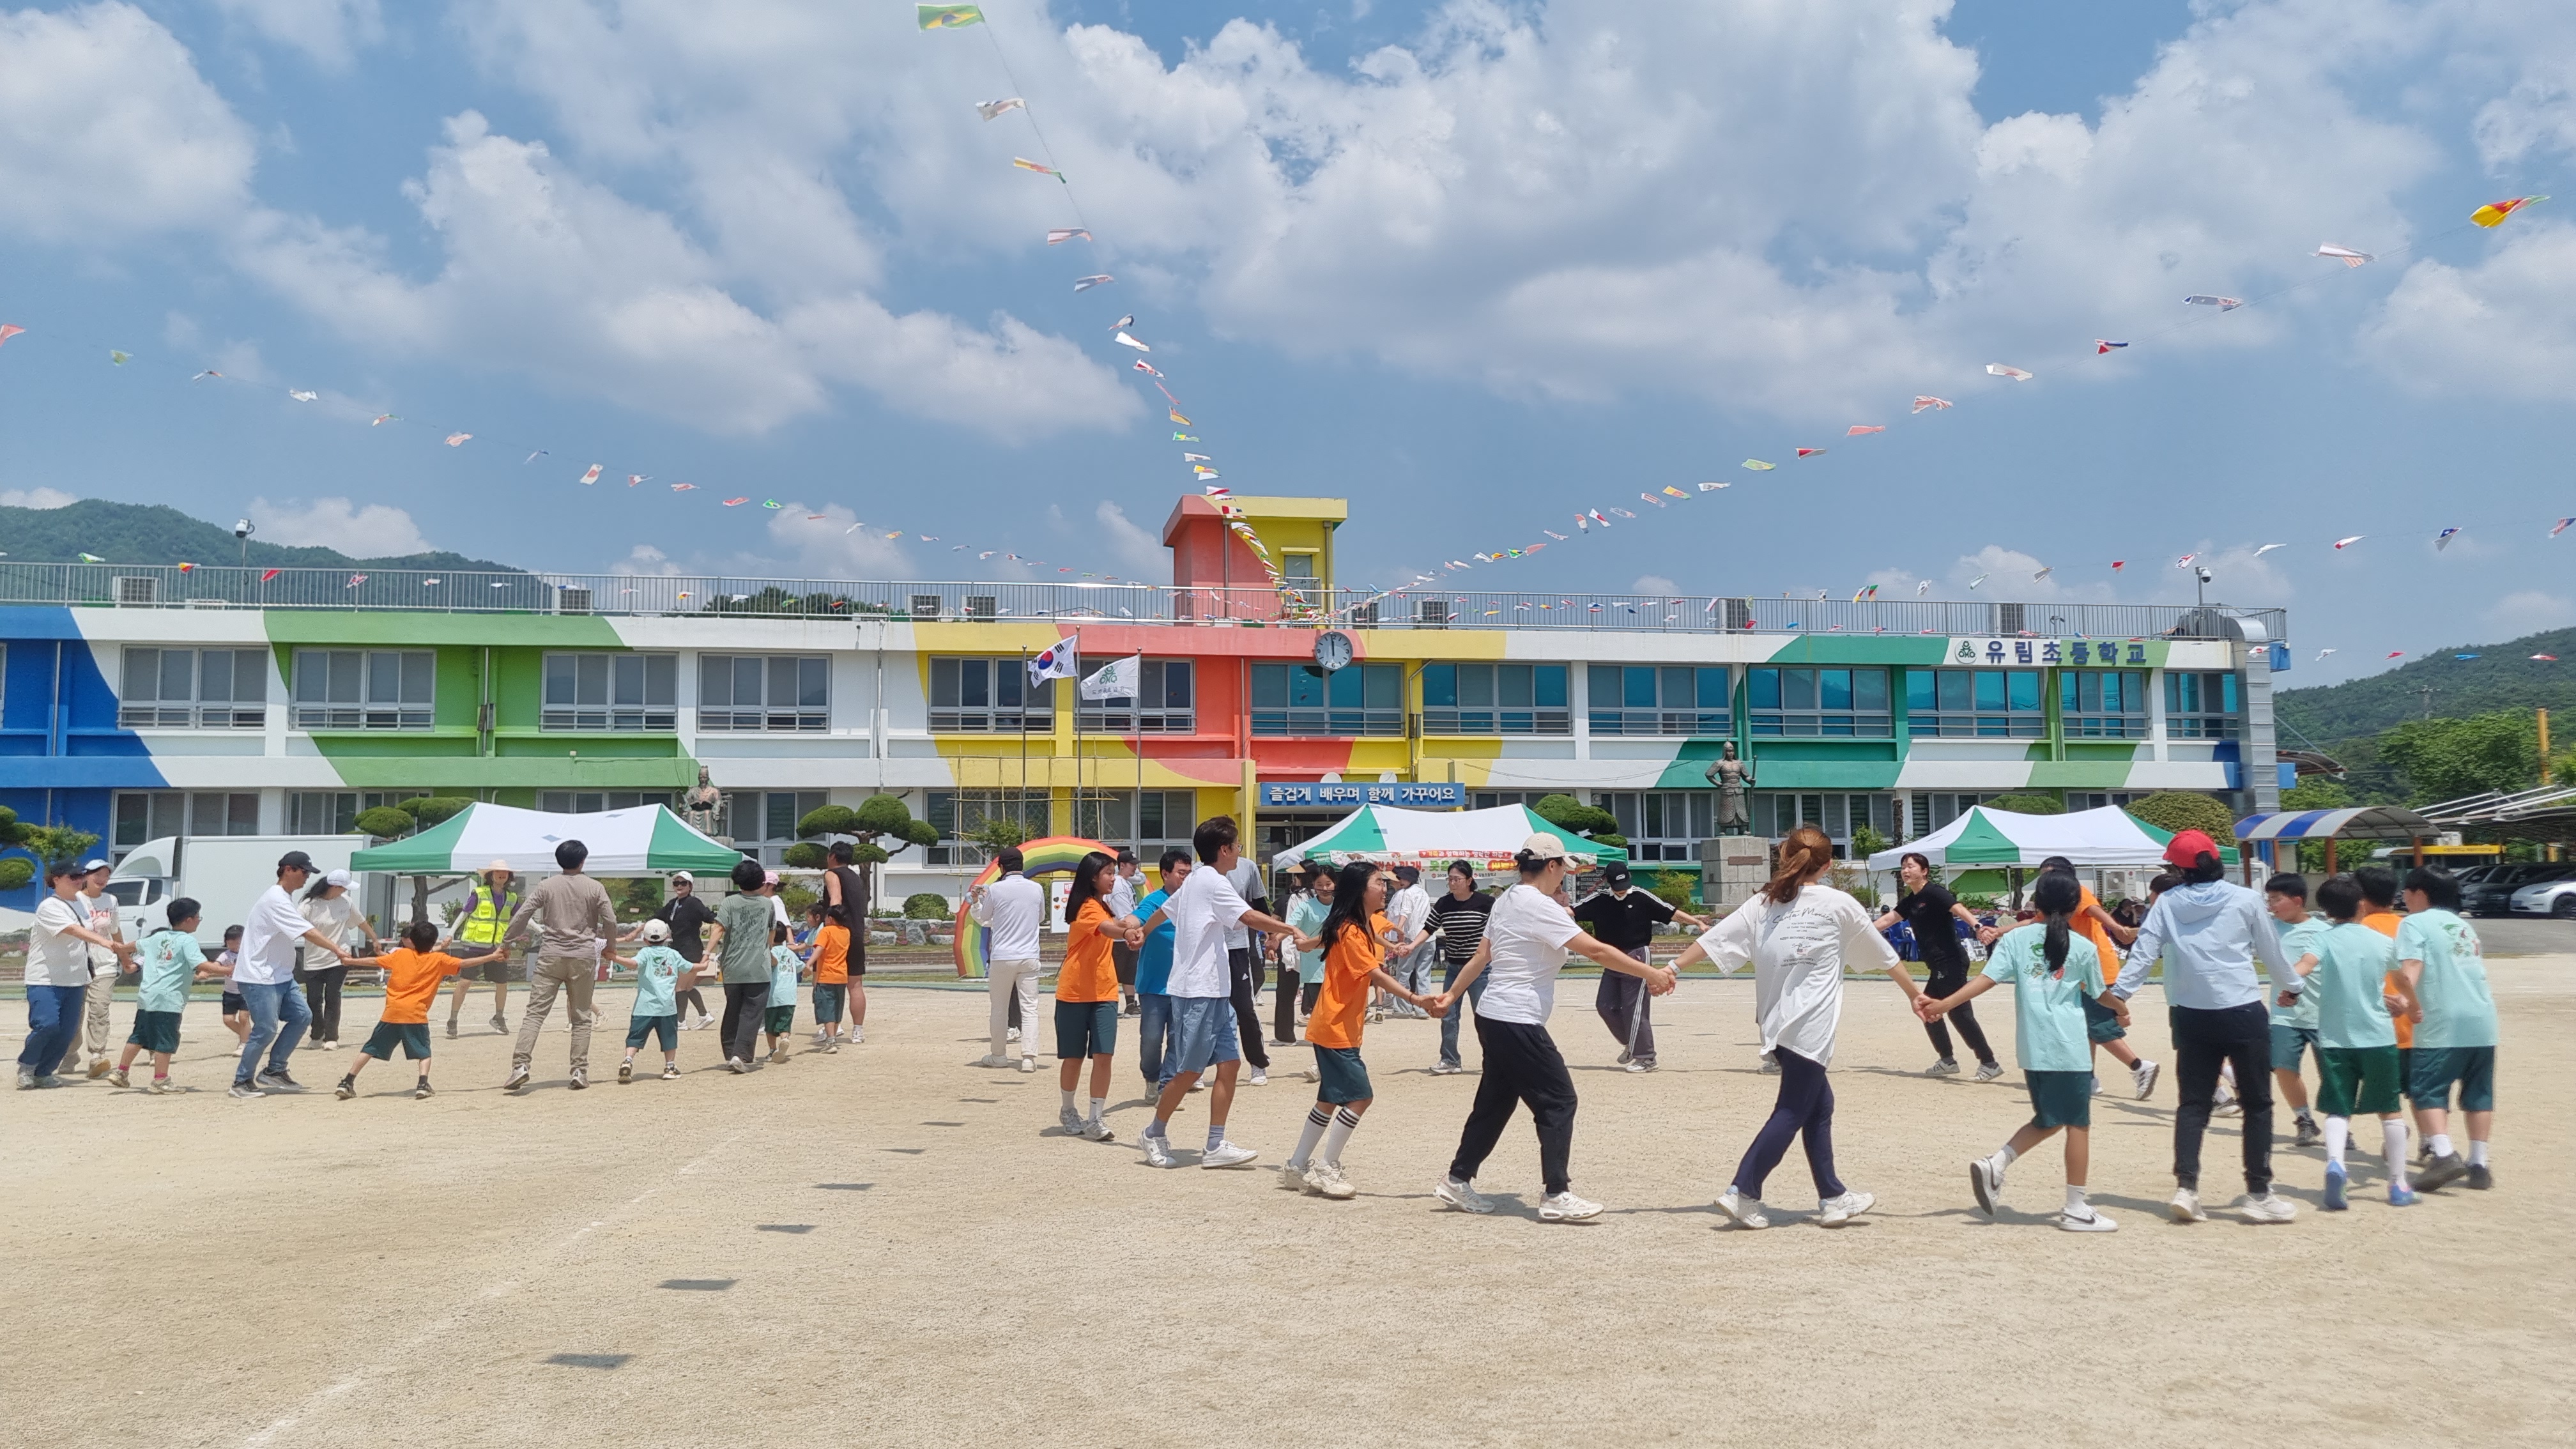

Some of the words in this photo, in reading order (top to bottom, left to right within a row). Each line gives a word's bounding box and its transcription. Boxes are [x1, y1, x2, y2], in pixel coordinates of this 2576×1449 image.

[1985, 640, 2147, 666] 유림초등학교
[1269, 786, 1312, 802] 즐겁게
[1319, 786, 1360, 802] 배우며
[1367, 786, 1395, 802] 함께
[1401, 786, 1456, 801] 가꾸어요
[1772, 910, 1800, 929] Santa
